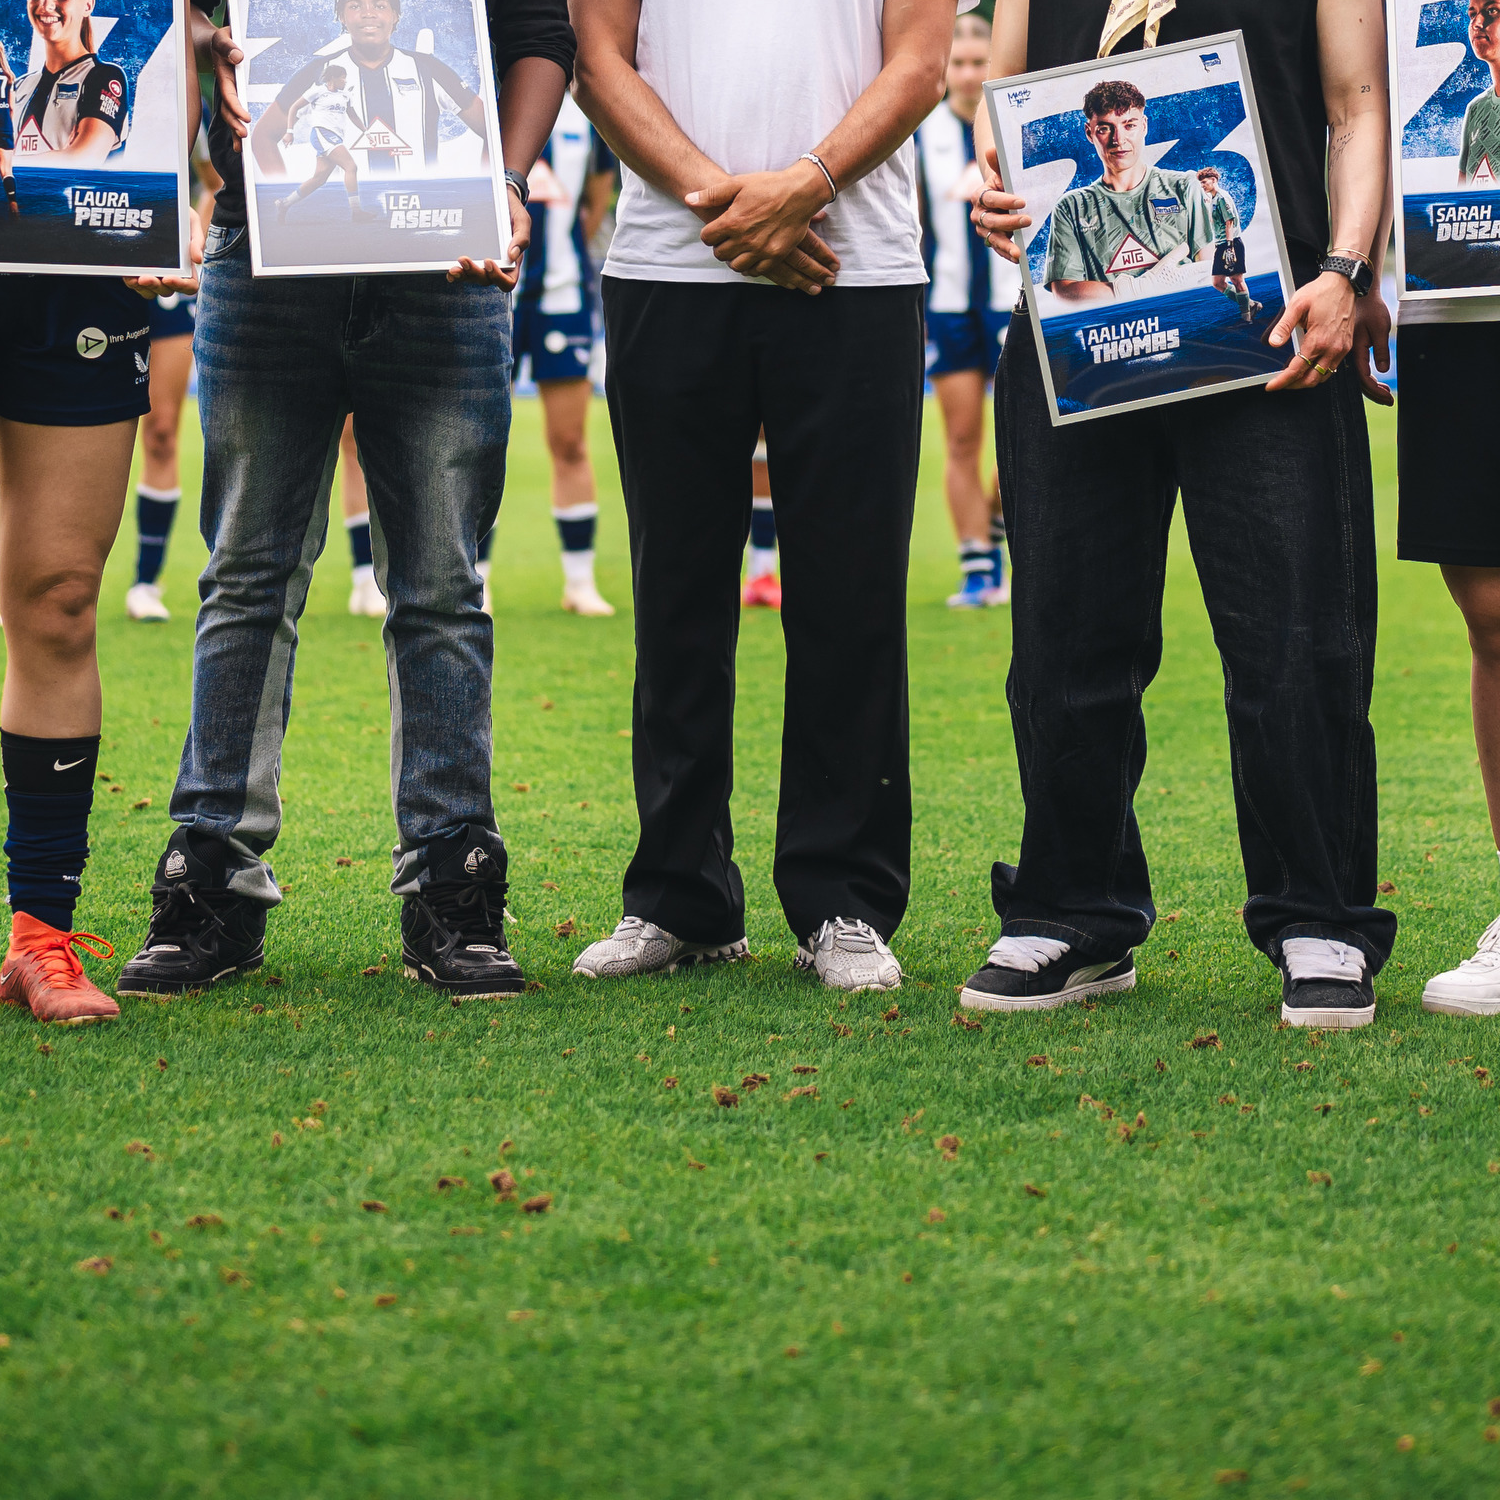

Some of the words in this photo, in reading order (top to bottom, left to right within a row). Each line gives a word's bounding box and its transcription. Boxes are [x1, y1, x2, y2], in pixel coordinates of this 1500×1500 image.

[1360, 84, 1371, 94] 23
[21, 134, 38, 151] WTG
[74, 190, 130, 208] LAURA
[389, 194, 421, 210] LEA
[74, 207, 153, 229] PETERS
[390, 208, 463, 228] ASEKO
[1436, 205, 1492, 222] SARAH
[1121, 248, 1144, 265] WTG
[109, 334, 125, 344] Ihre
[1087, 316, 1160, 346] AALIYAH
[1090, 328, 1180, 364] THOMAS
